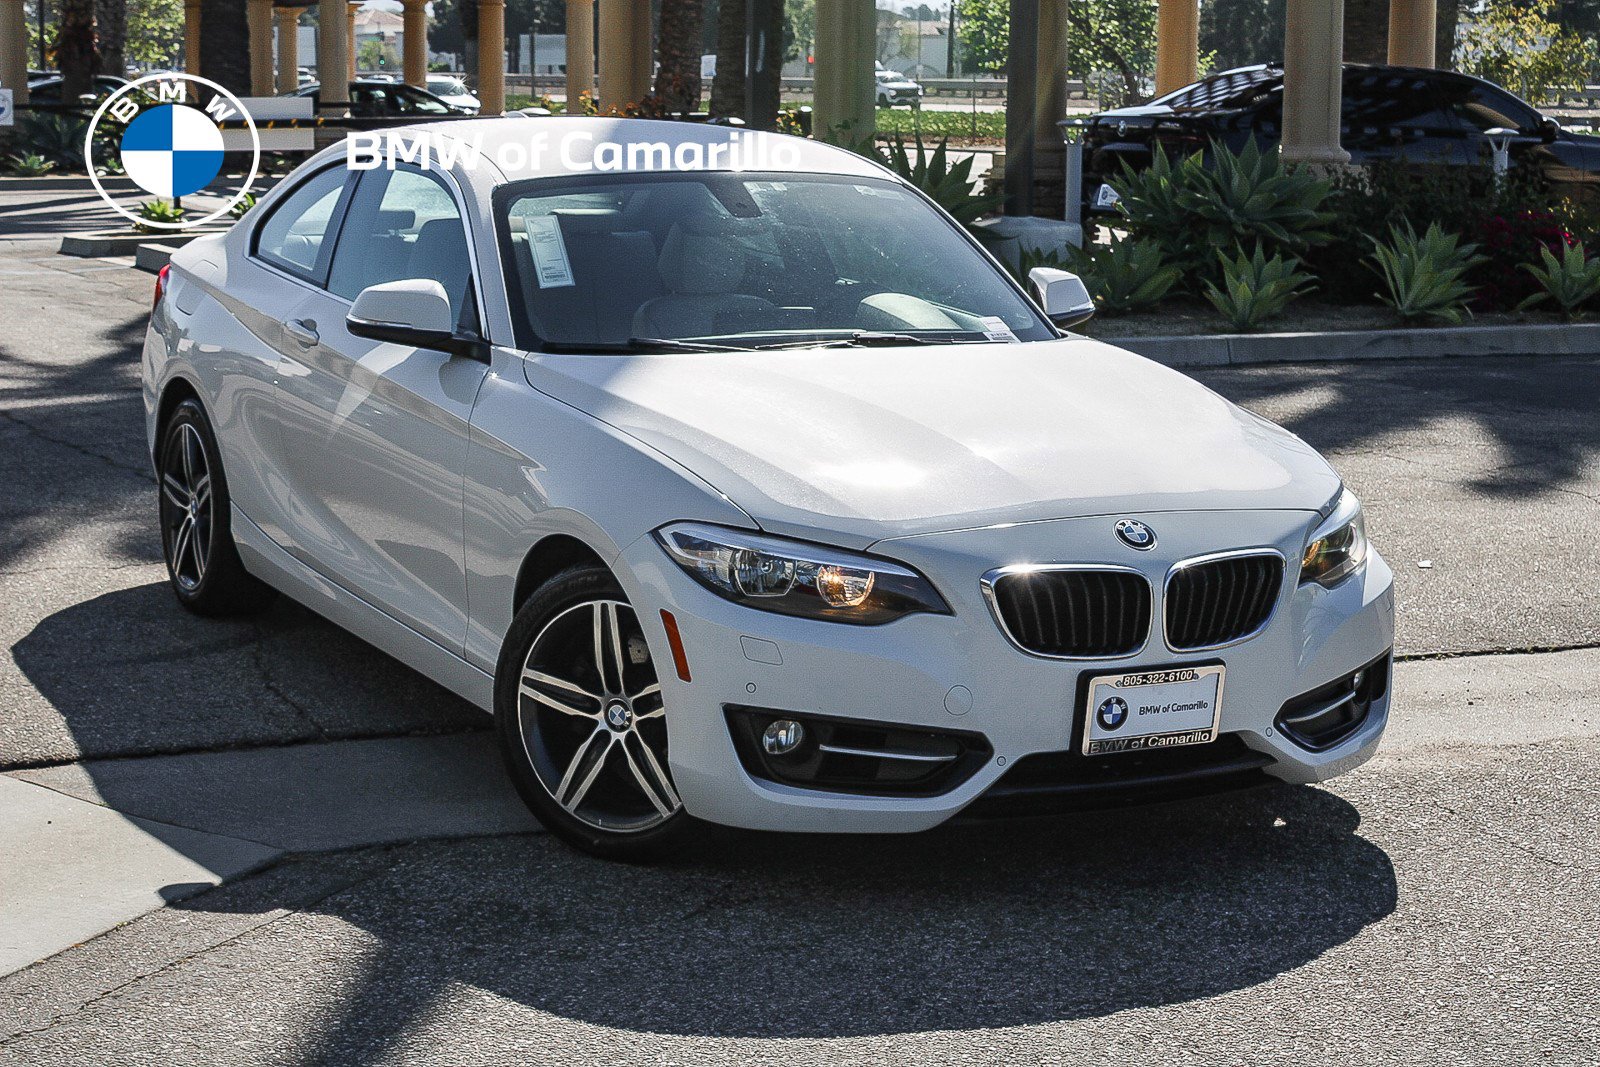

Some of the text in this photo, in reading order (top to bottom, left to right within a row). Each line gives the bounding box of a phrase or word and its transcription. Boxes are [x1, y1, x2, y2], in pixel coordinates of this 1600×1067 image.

[1123, 670, 1193, 686] 805-322-6100
[1138, 700, 1208, 716] BMW of Camarillo
[1090, 731, 1209, 754] BMW of Camarillo
